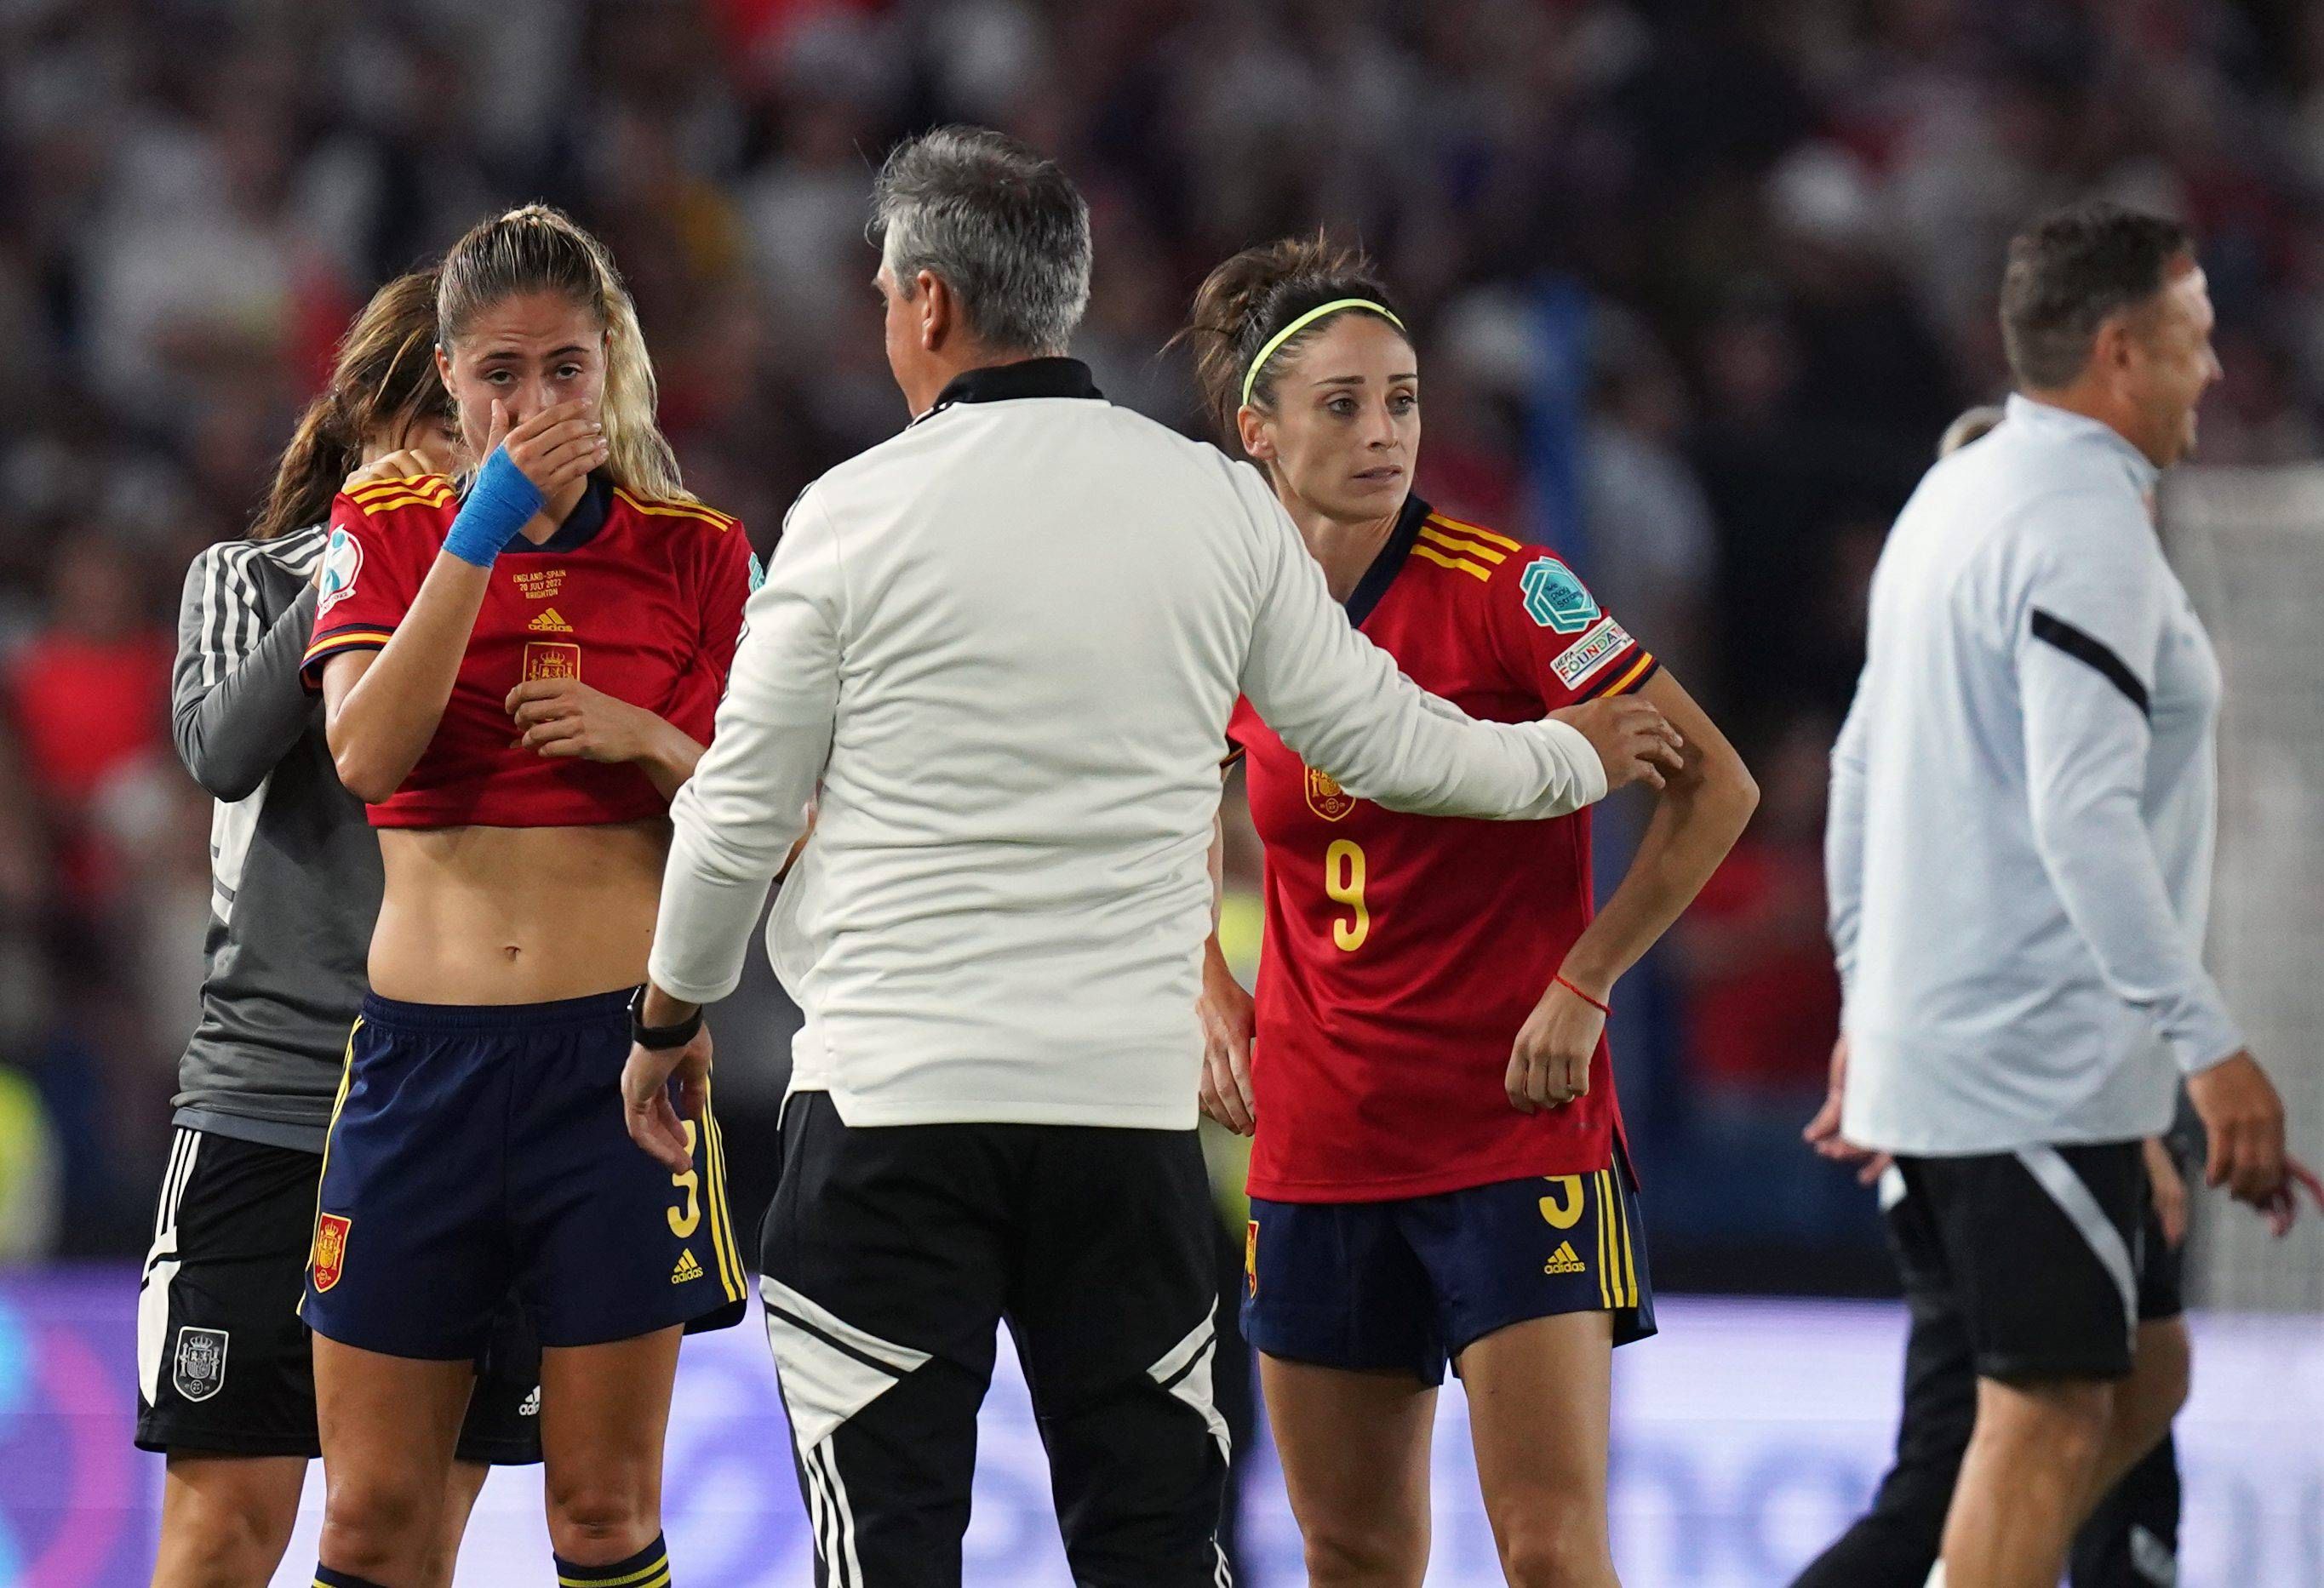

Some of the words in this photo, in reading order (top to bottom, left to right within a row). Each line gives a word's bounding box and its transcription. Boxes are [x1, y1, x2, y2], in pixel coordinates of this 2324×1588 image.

[512, 569, 567, 583] ENGLAND-SPAIN
[519, 583, 528, 591] 20
[529, 581, 545, 591] JULY
[546, 579, 562, 589] 2022
[525, 588, 558, 599] BRIGHTON
[528, 622, 574, 632] adidas
[1554, 651, 1576, 670] UEFA
[1559, 627, 1624, 680] FOUNDAT
[1325, 839, 1370, 951] 9
[1543, 1261, 1586, 1275] adidas
[671, 1266, 703, 1285] adidas
